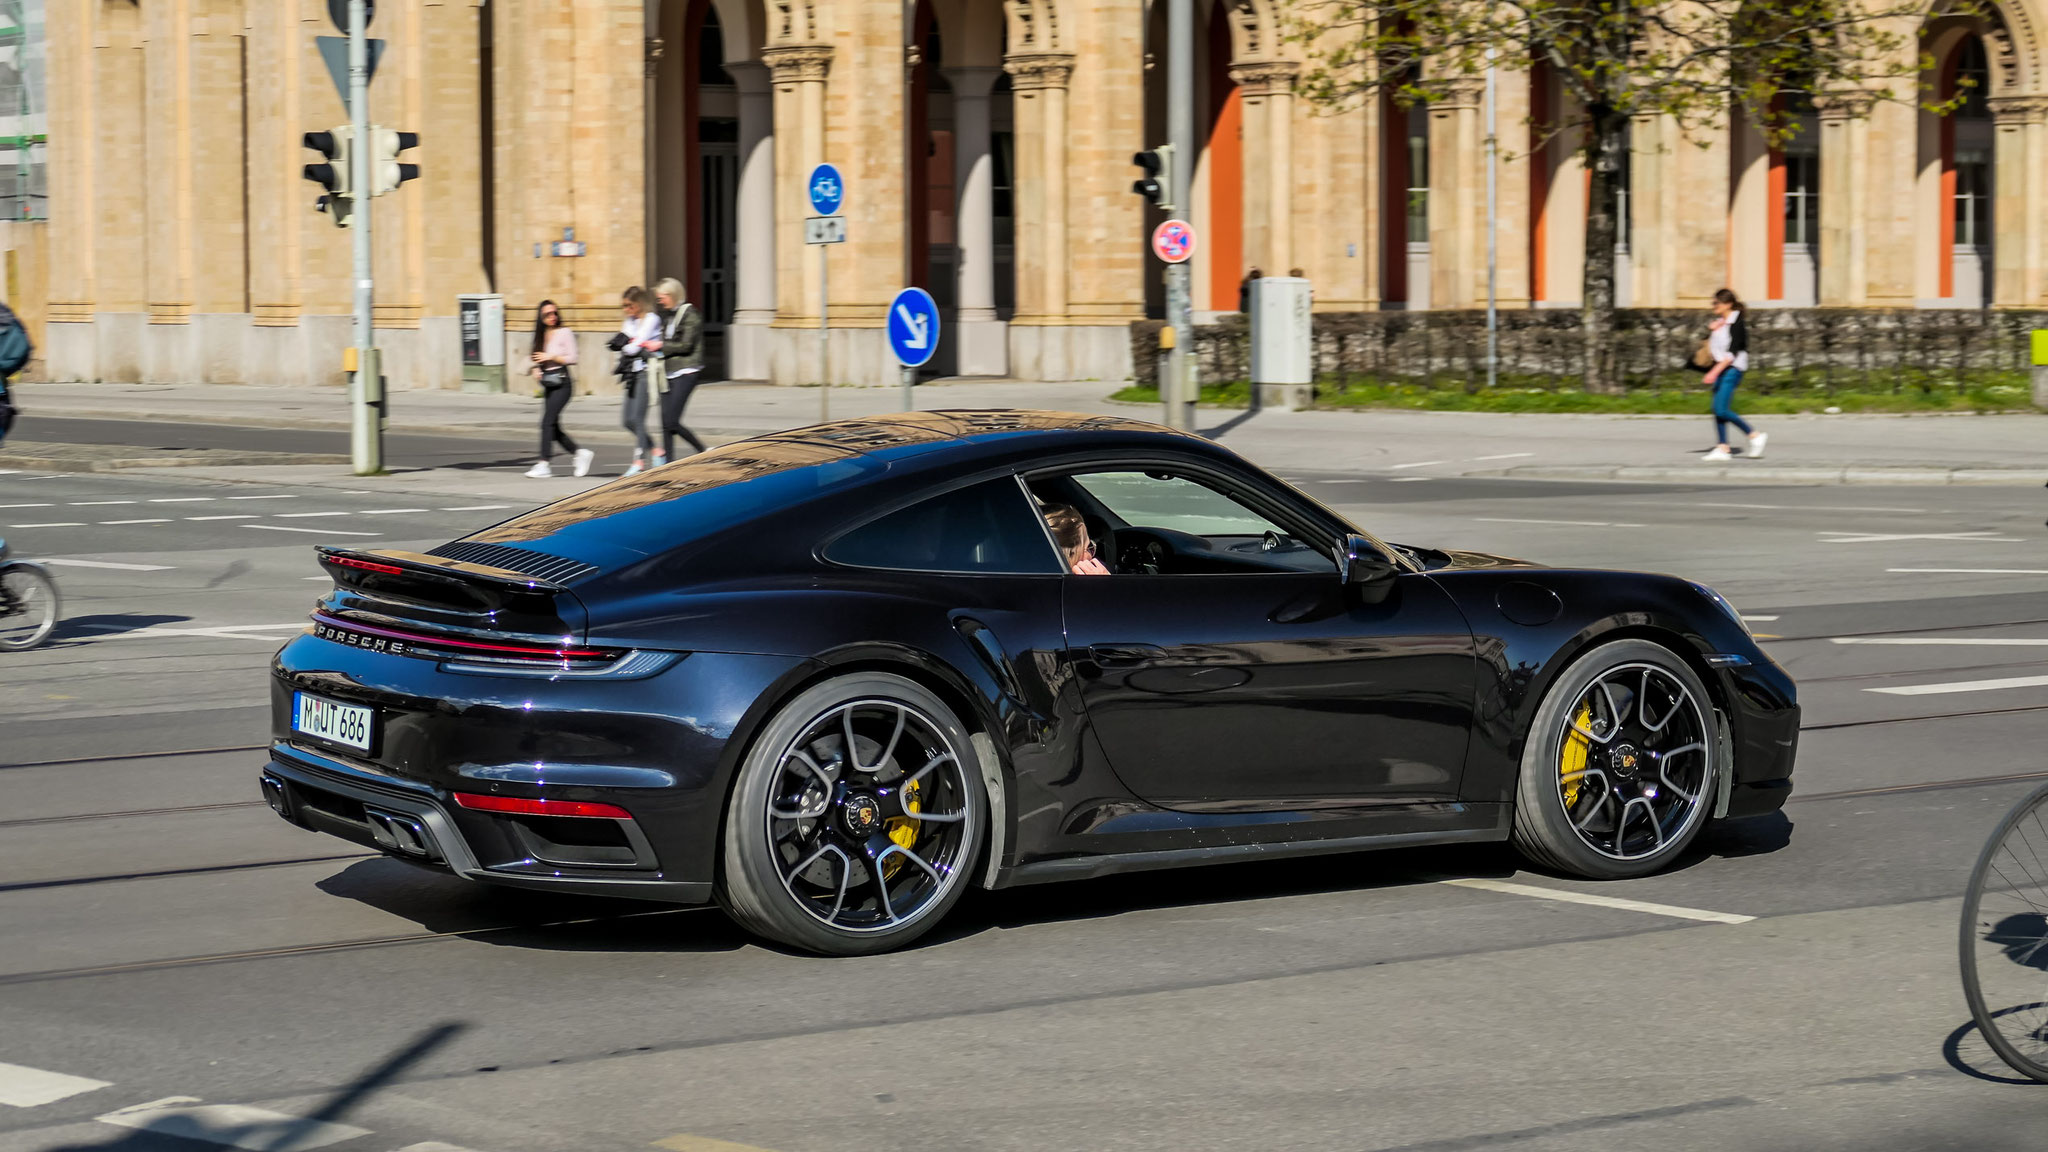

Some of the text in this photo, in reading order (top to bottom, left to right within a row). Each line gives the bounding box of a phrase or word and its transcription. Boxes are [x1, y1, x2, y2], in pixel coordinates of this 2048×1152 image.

[318, 625, 403, 653] PORSCHE
[304, 698, 313, 729] M
[340, 708, 364, 743] 686
